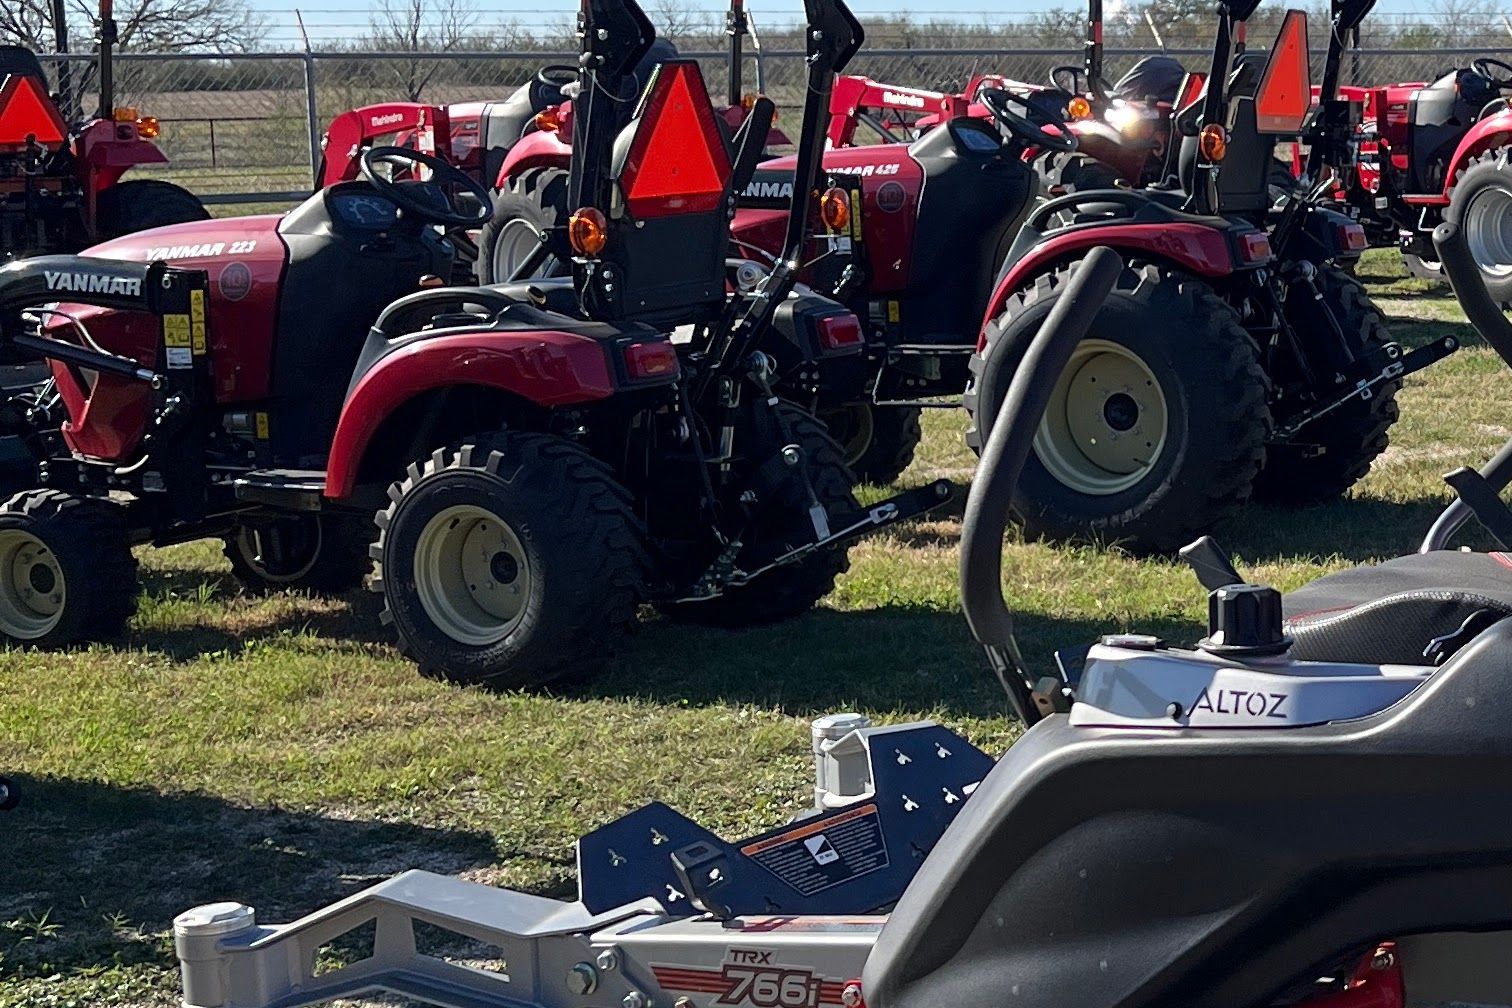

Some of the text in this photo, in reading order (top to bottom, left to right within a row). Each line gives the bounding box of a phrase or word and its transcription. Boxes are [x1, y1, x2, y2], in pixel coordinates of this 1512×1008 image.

[740, 182, 794, 198] NMA
[146, 240, 257, 262] YANMAR 223
[44, 270, 142, 297] YANMAR
[1186, 686, 1289, 719] ALTOZ
[730, 949, 773, 965] TRX
[724, 968, 819, 1008] 766i
